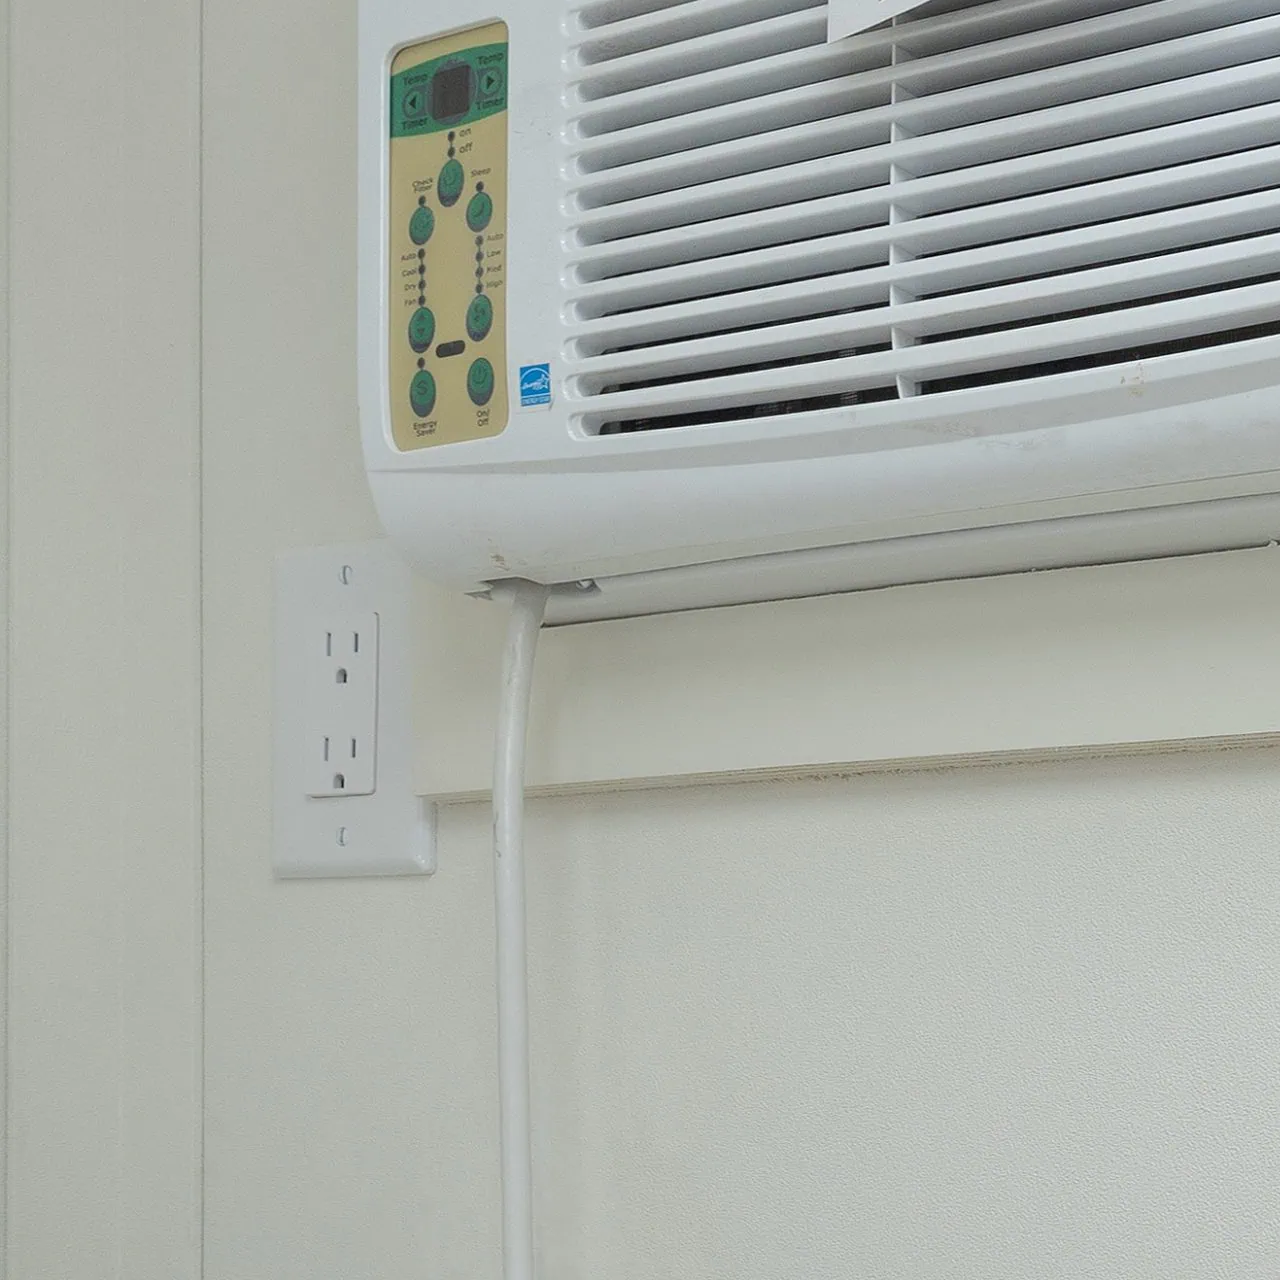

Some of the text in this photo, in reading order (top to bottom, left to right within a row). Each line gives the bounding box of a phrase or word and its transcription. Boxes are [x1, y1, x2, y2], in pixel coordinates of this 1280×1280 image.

[477, 53, 504, 65] Temp
[404, 74, 428, 85] Temp
[475, 97, 504, 110] Timer
[402, 118, 428, 130] Timer
[459, 128, 472, 137] on
[459, 142, 473, 153] off
[413, 420, 437, 431] Energy
